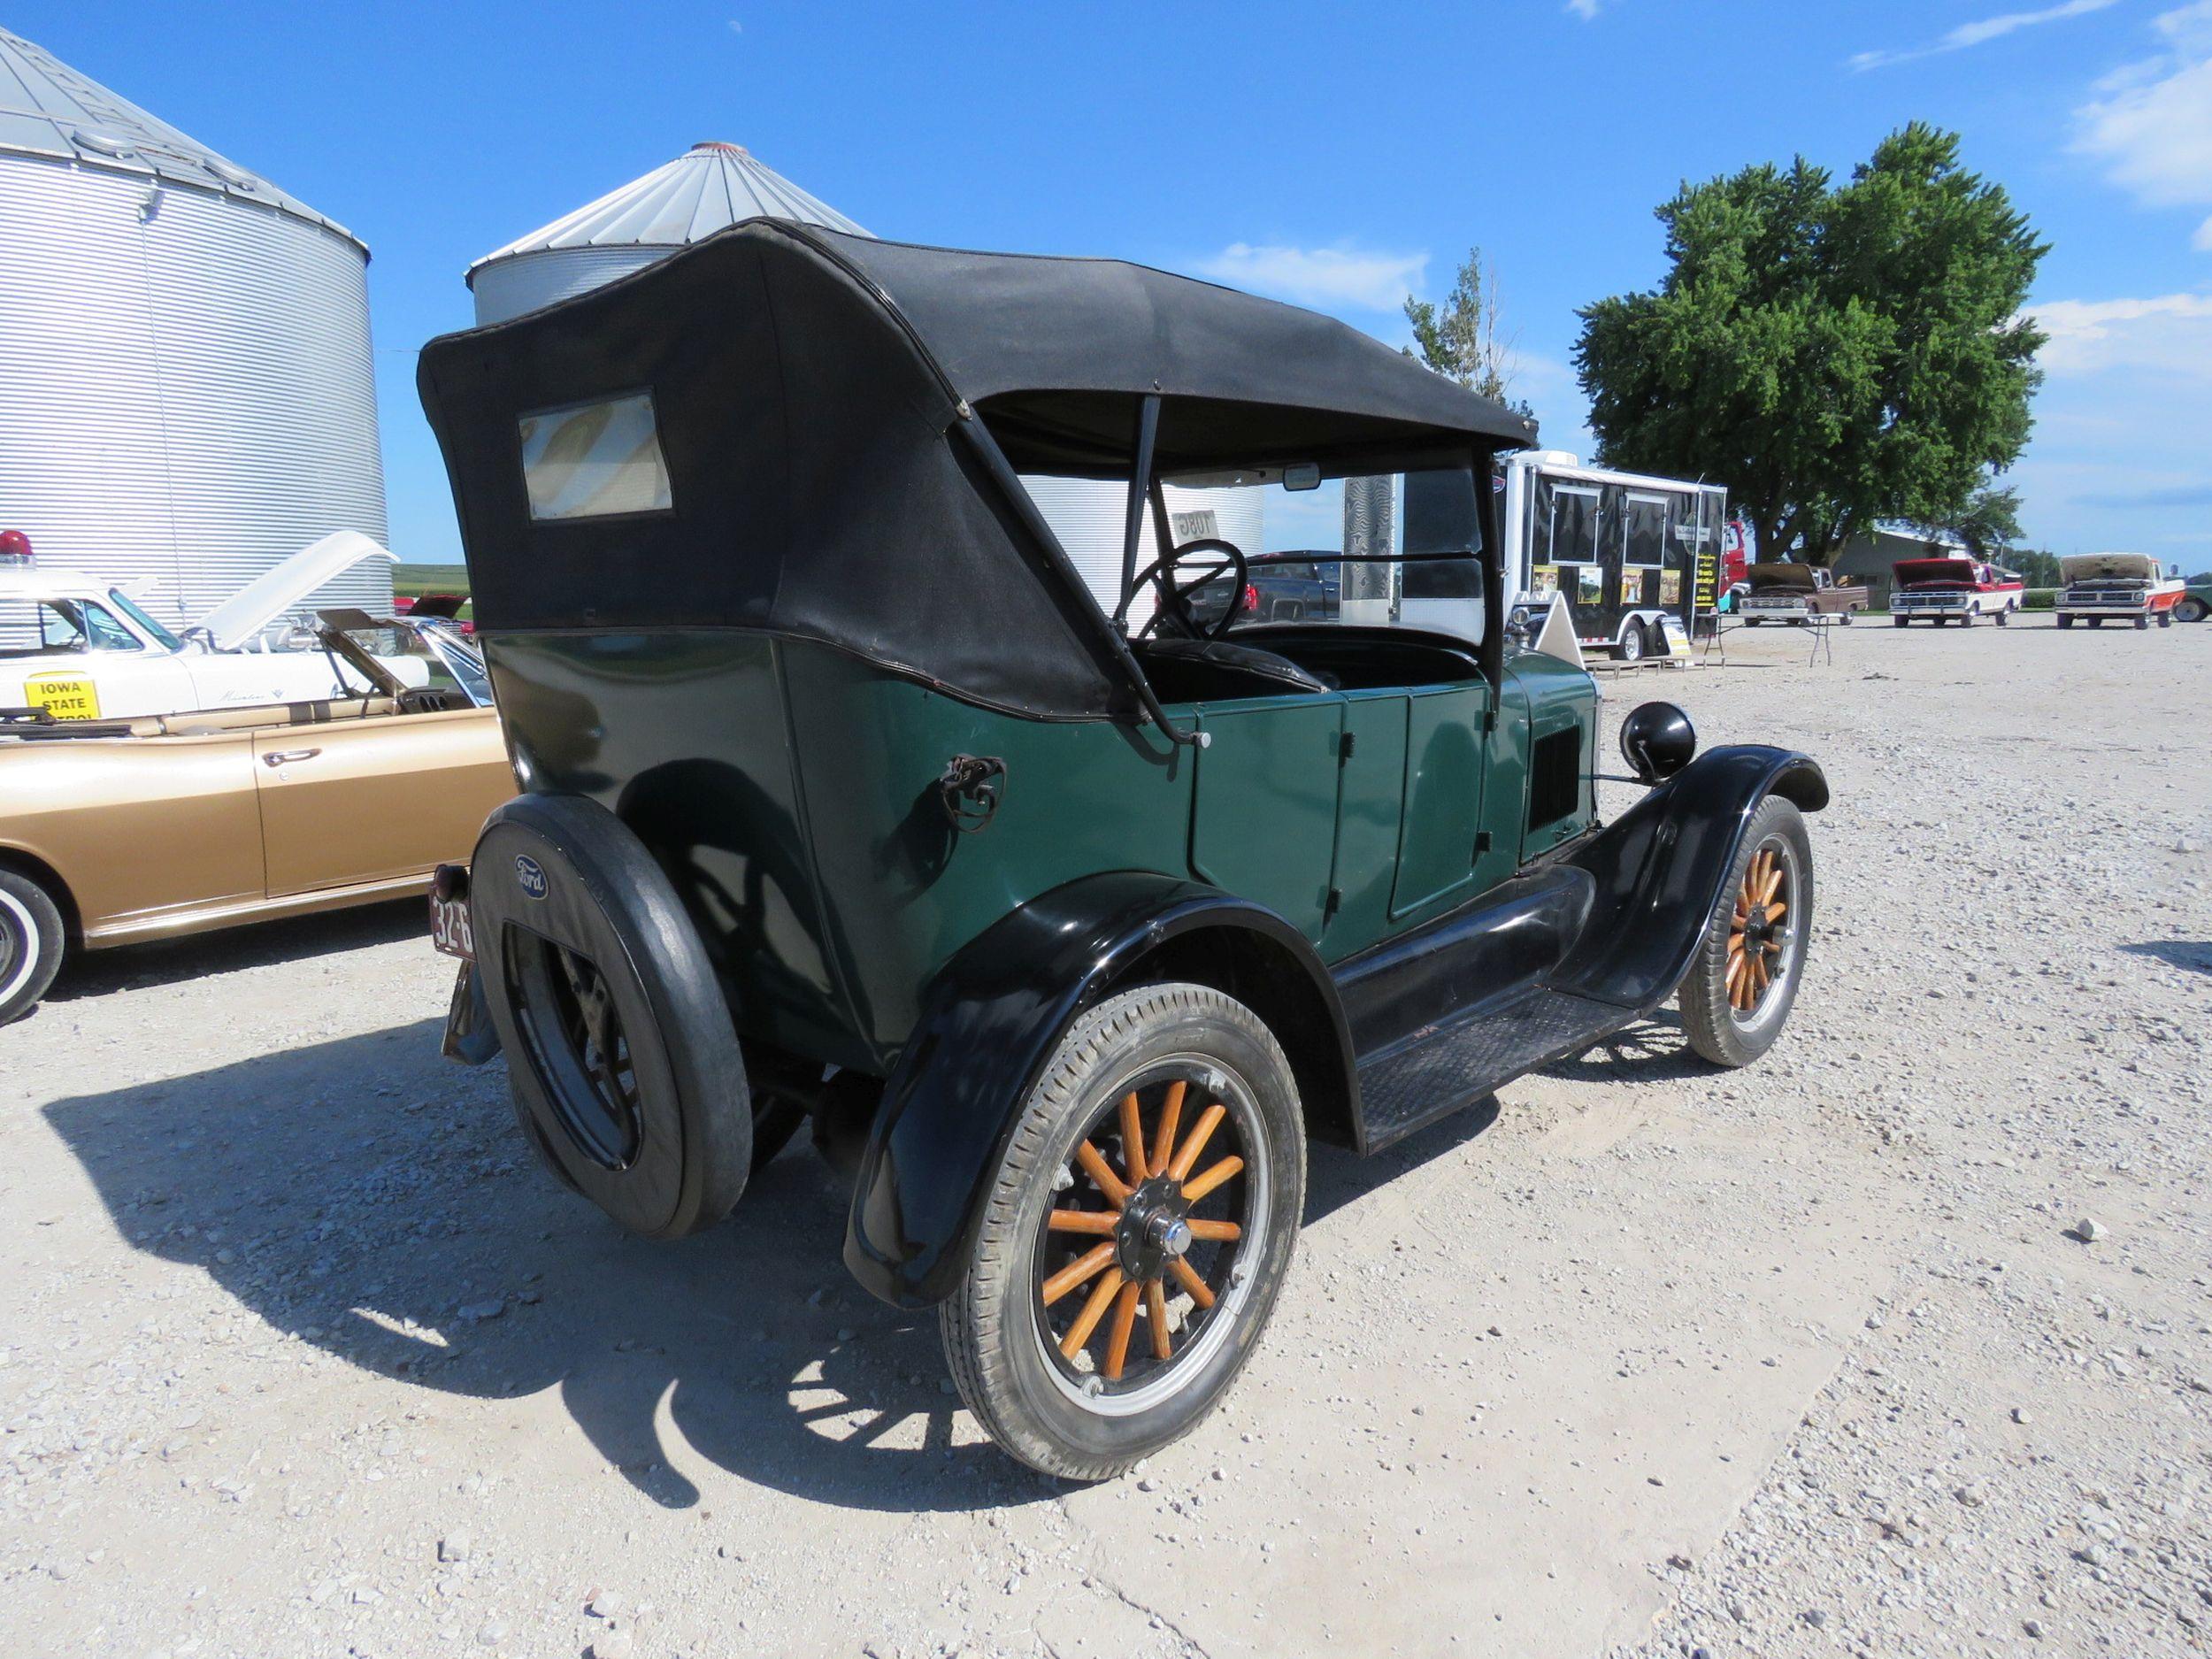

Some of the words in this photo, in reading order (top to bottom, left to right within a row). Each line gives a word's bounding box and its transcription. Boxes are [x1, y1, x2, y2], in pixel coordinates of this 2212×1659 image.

[40, 682, 81, 695] IOWA
[42, 697, 87, 710] STATE
[517, 859, 545, 891] Ford
